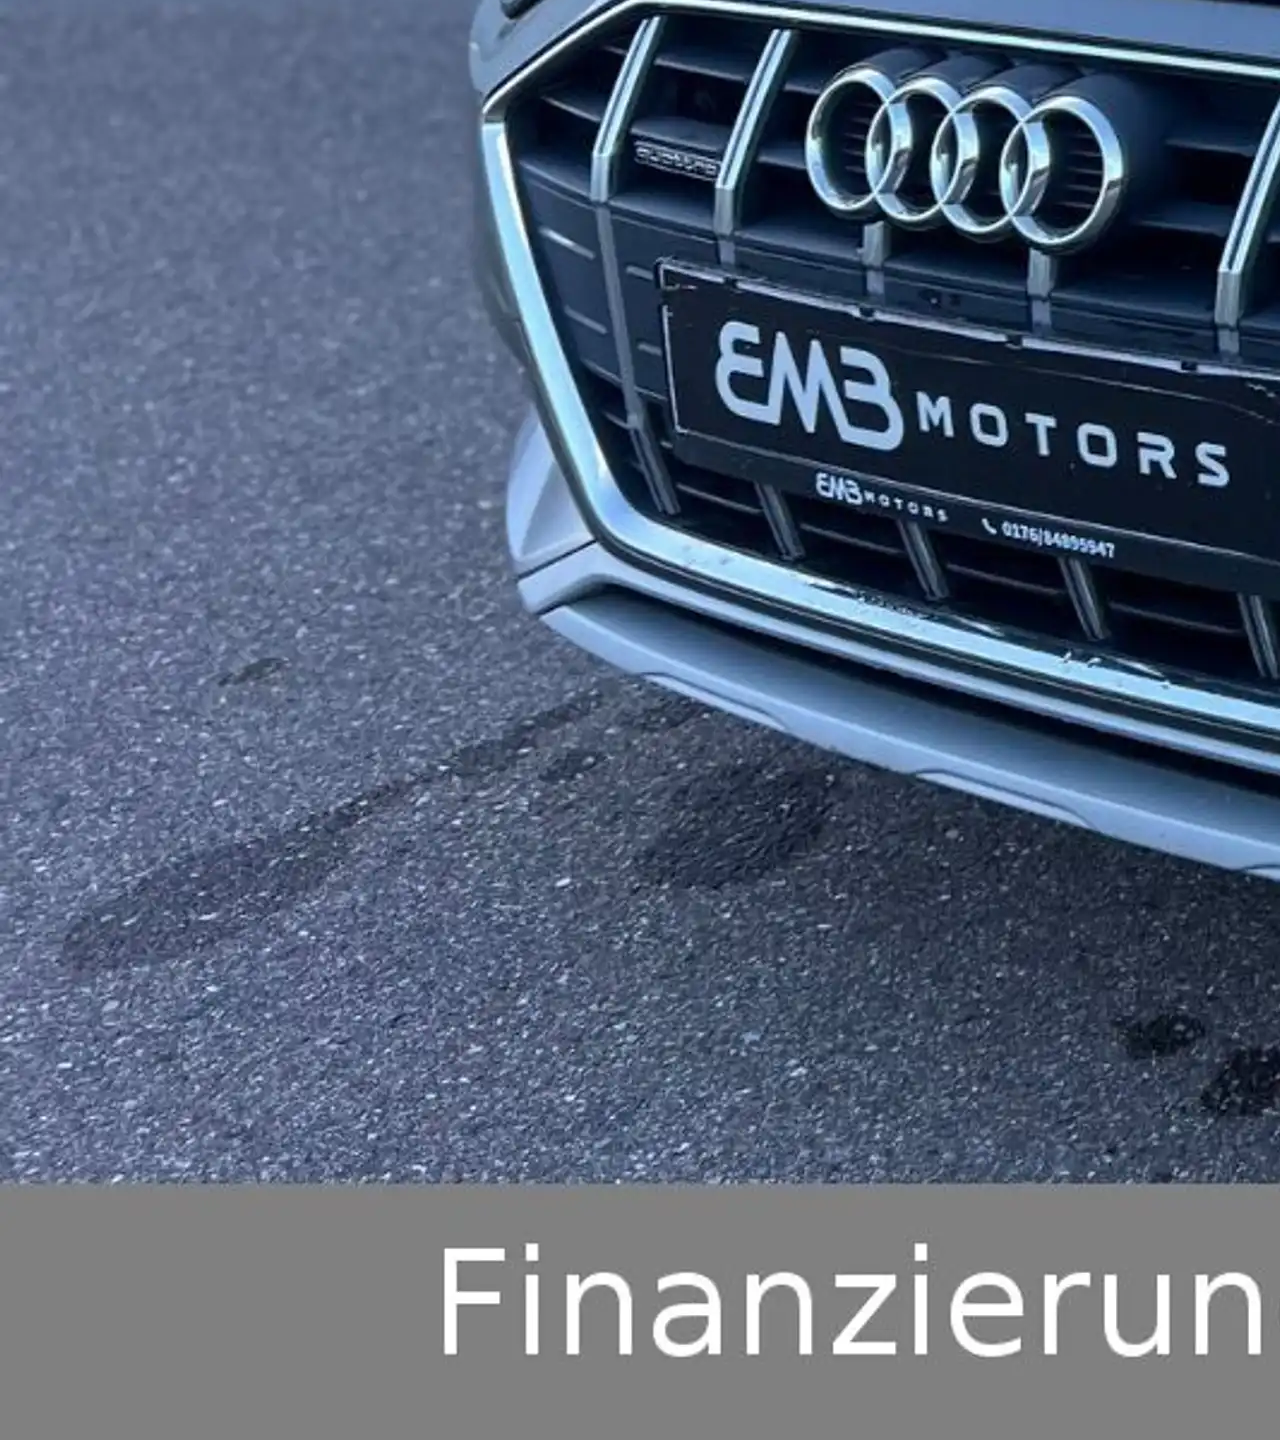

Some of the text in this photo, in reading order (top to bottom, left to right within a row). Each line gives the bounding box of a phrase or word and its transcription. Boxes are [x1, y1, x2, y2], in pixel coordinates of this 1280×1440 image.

[714, 320, 1231, 489] EMB MOTORS
[863, 489, 950, 524] MOTORS
